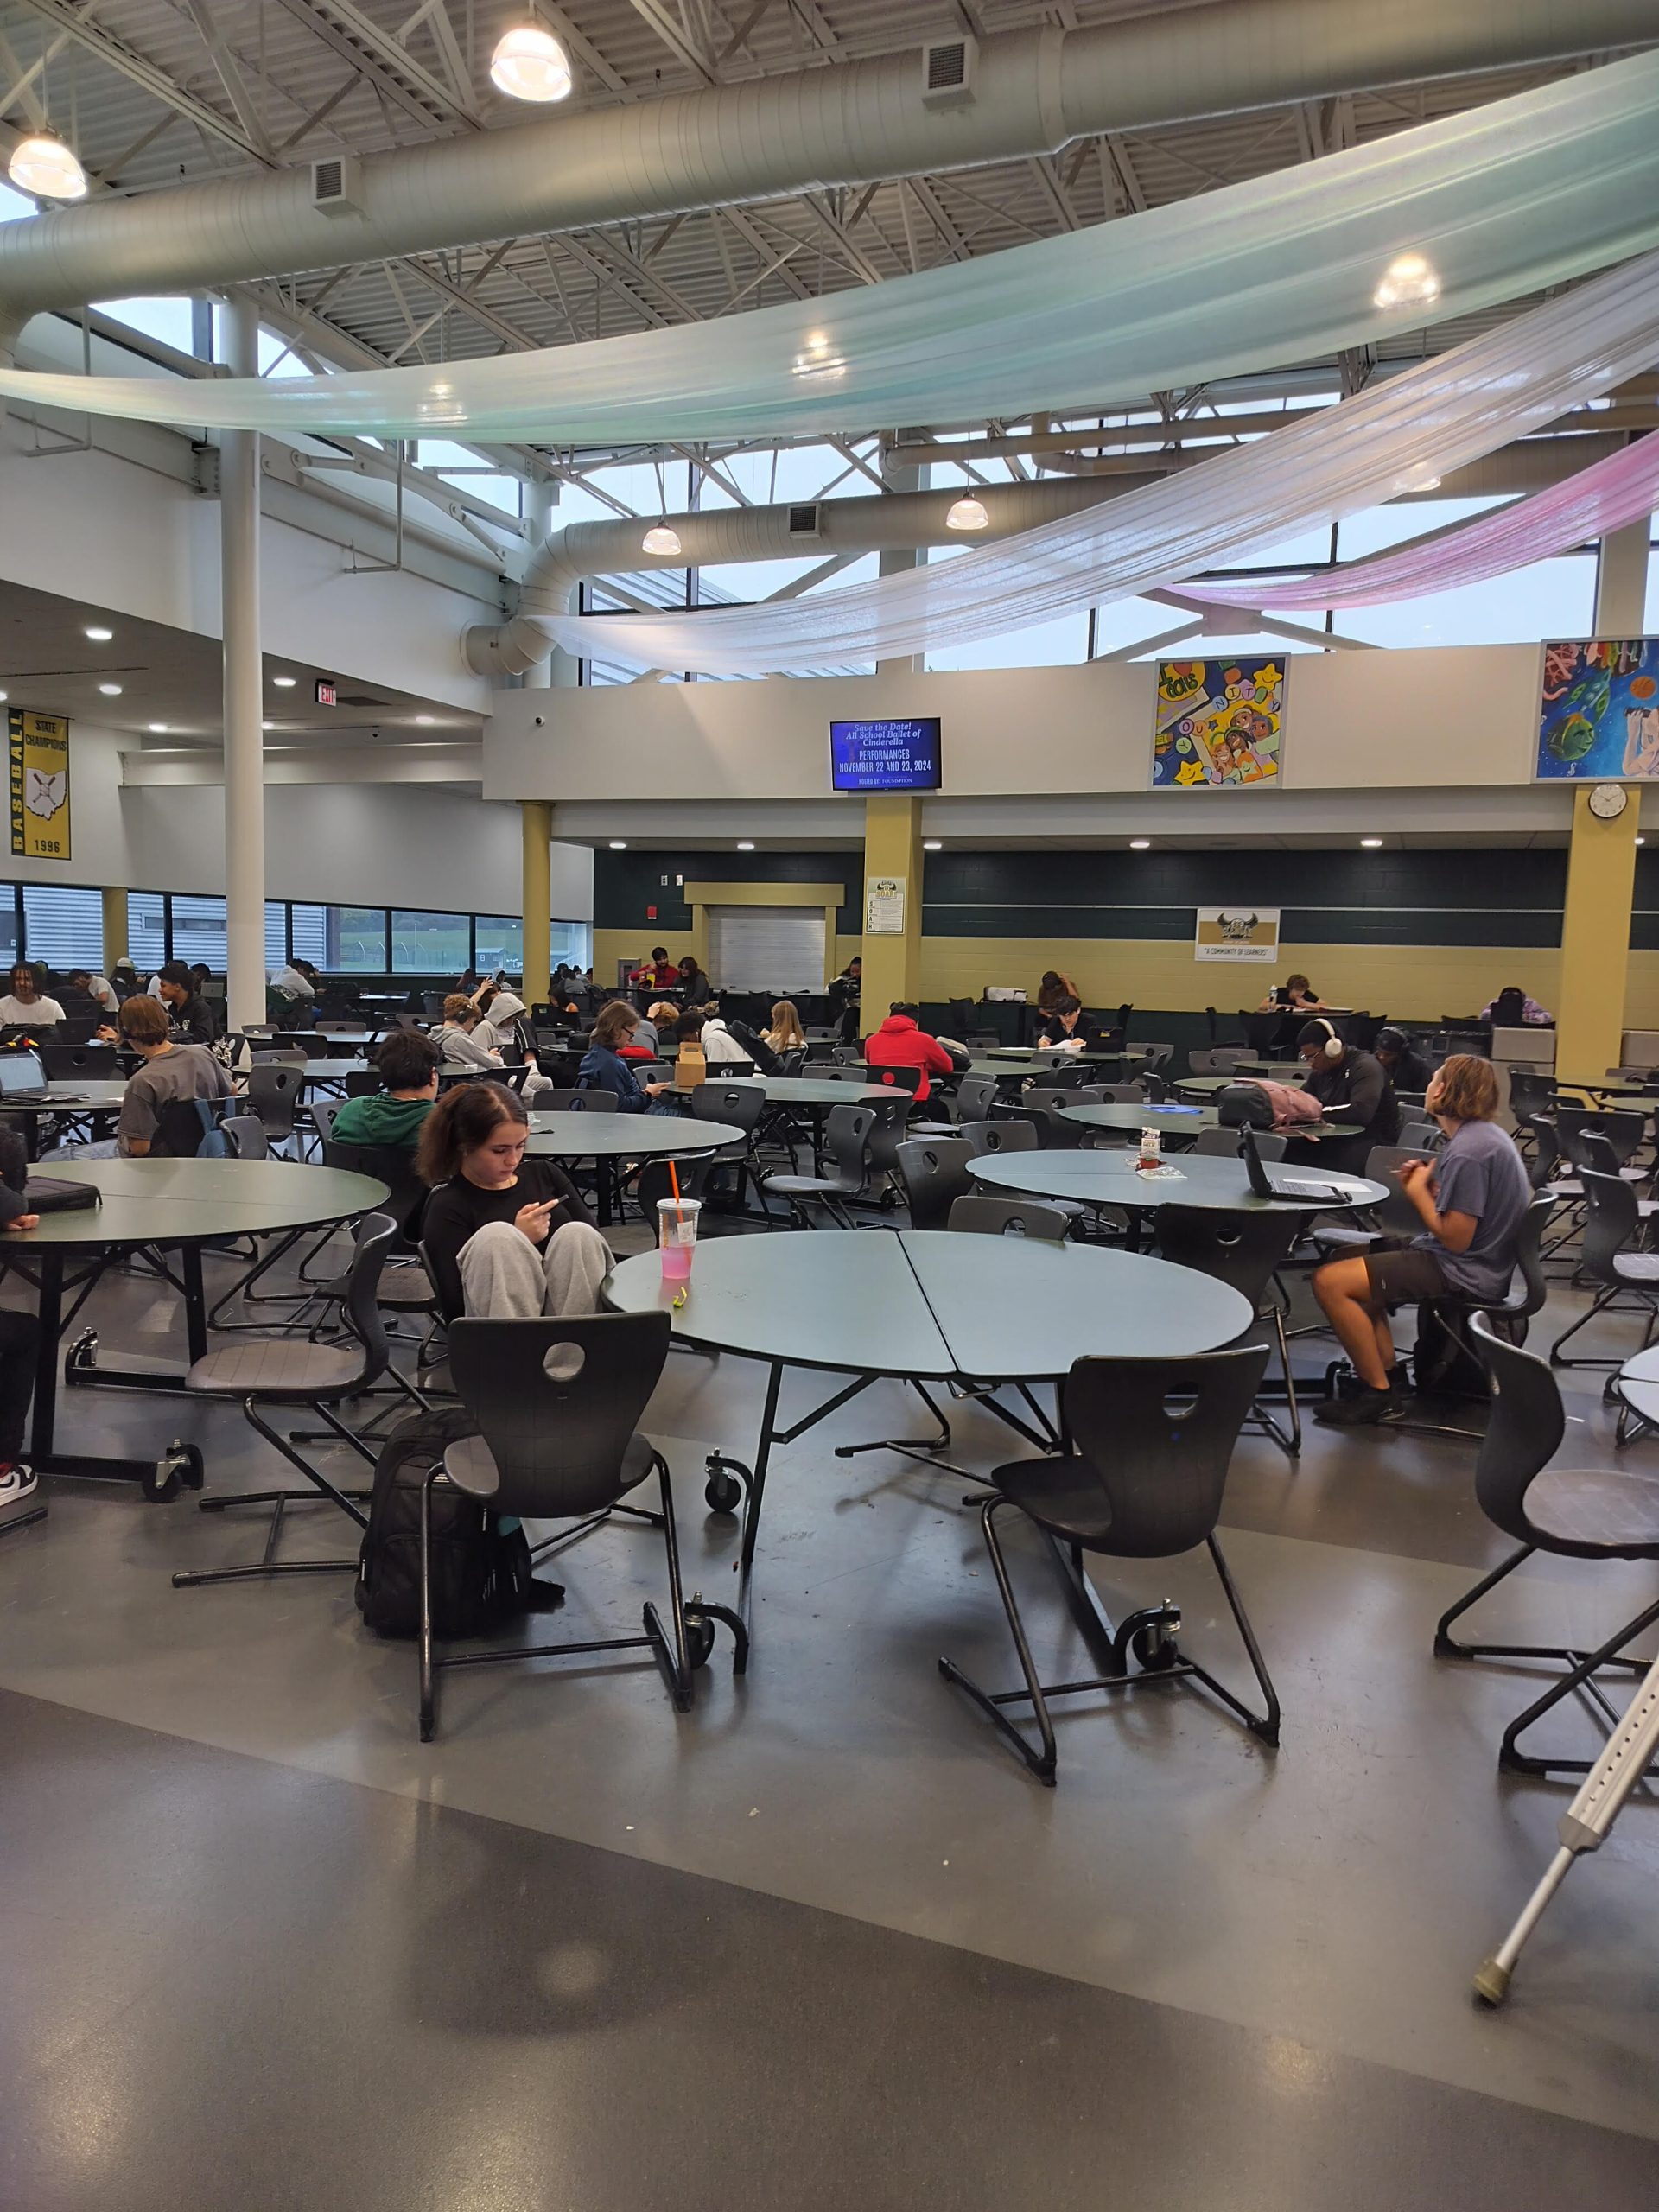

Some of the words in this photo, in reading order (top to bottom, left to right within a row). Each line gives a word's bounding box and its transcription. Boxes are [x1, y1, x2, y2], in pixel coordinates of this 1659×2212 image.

[321, 686, 334, 703] EXIT
[35, 720, 56, 734] STATE
[890, 722, 912, 731] Date!
[912, 729, 922, 739] of
[25, 734, 67, 751] CHAMPIONS
[863, 738, 904, 747] Cinderella
[859, 749, 910, 760] PERFORMANCES
[839, 762, 874, 772] NOVEMBER
[875, 762, 884, 772] 22
[886, 761, 899, 772] AND
[901, 761, 912, 772] 23,
[914, 760, 931, 771] 2024
[10, 714, 23, 850] BASEBALL
[35, 839, 60, 853] 1996
